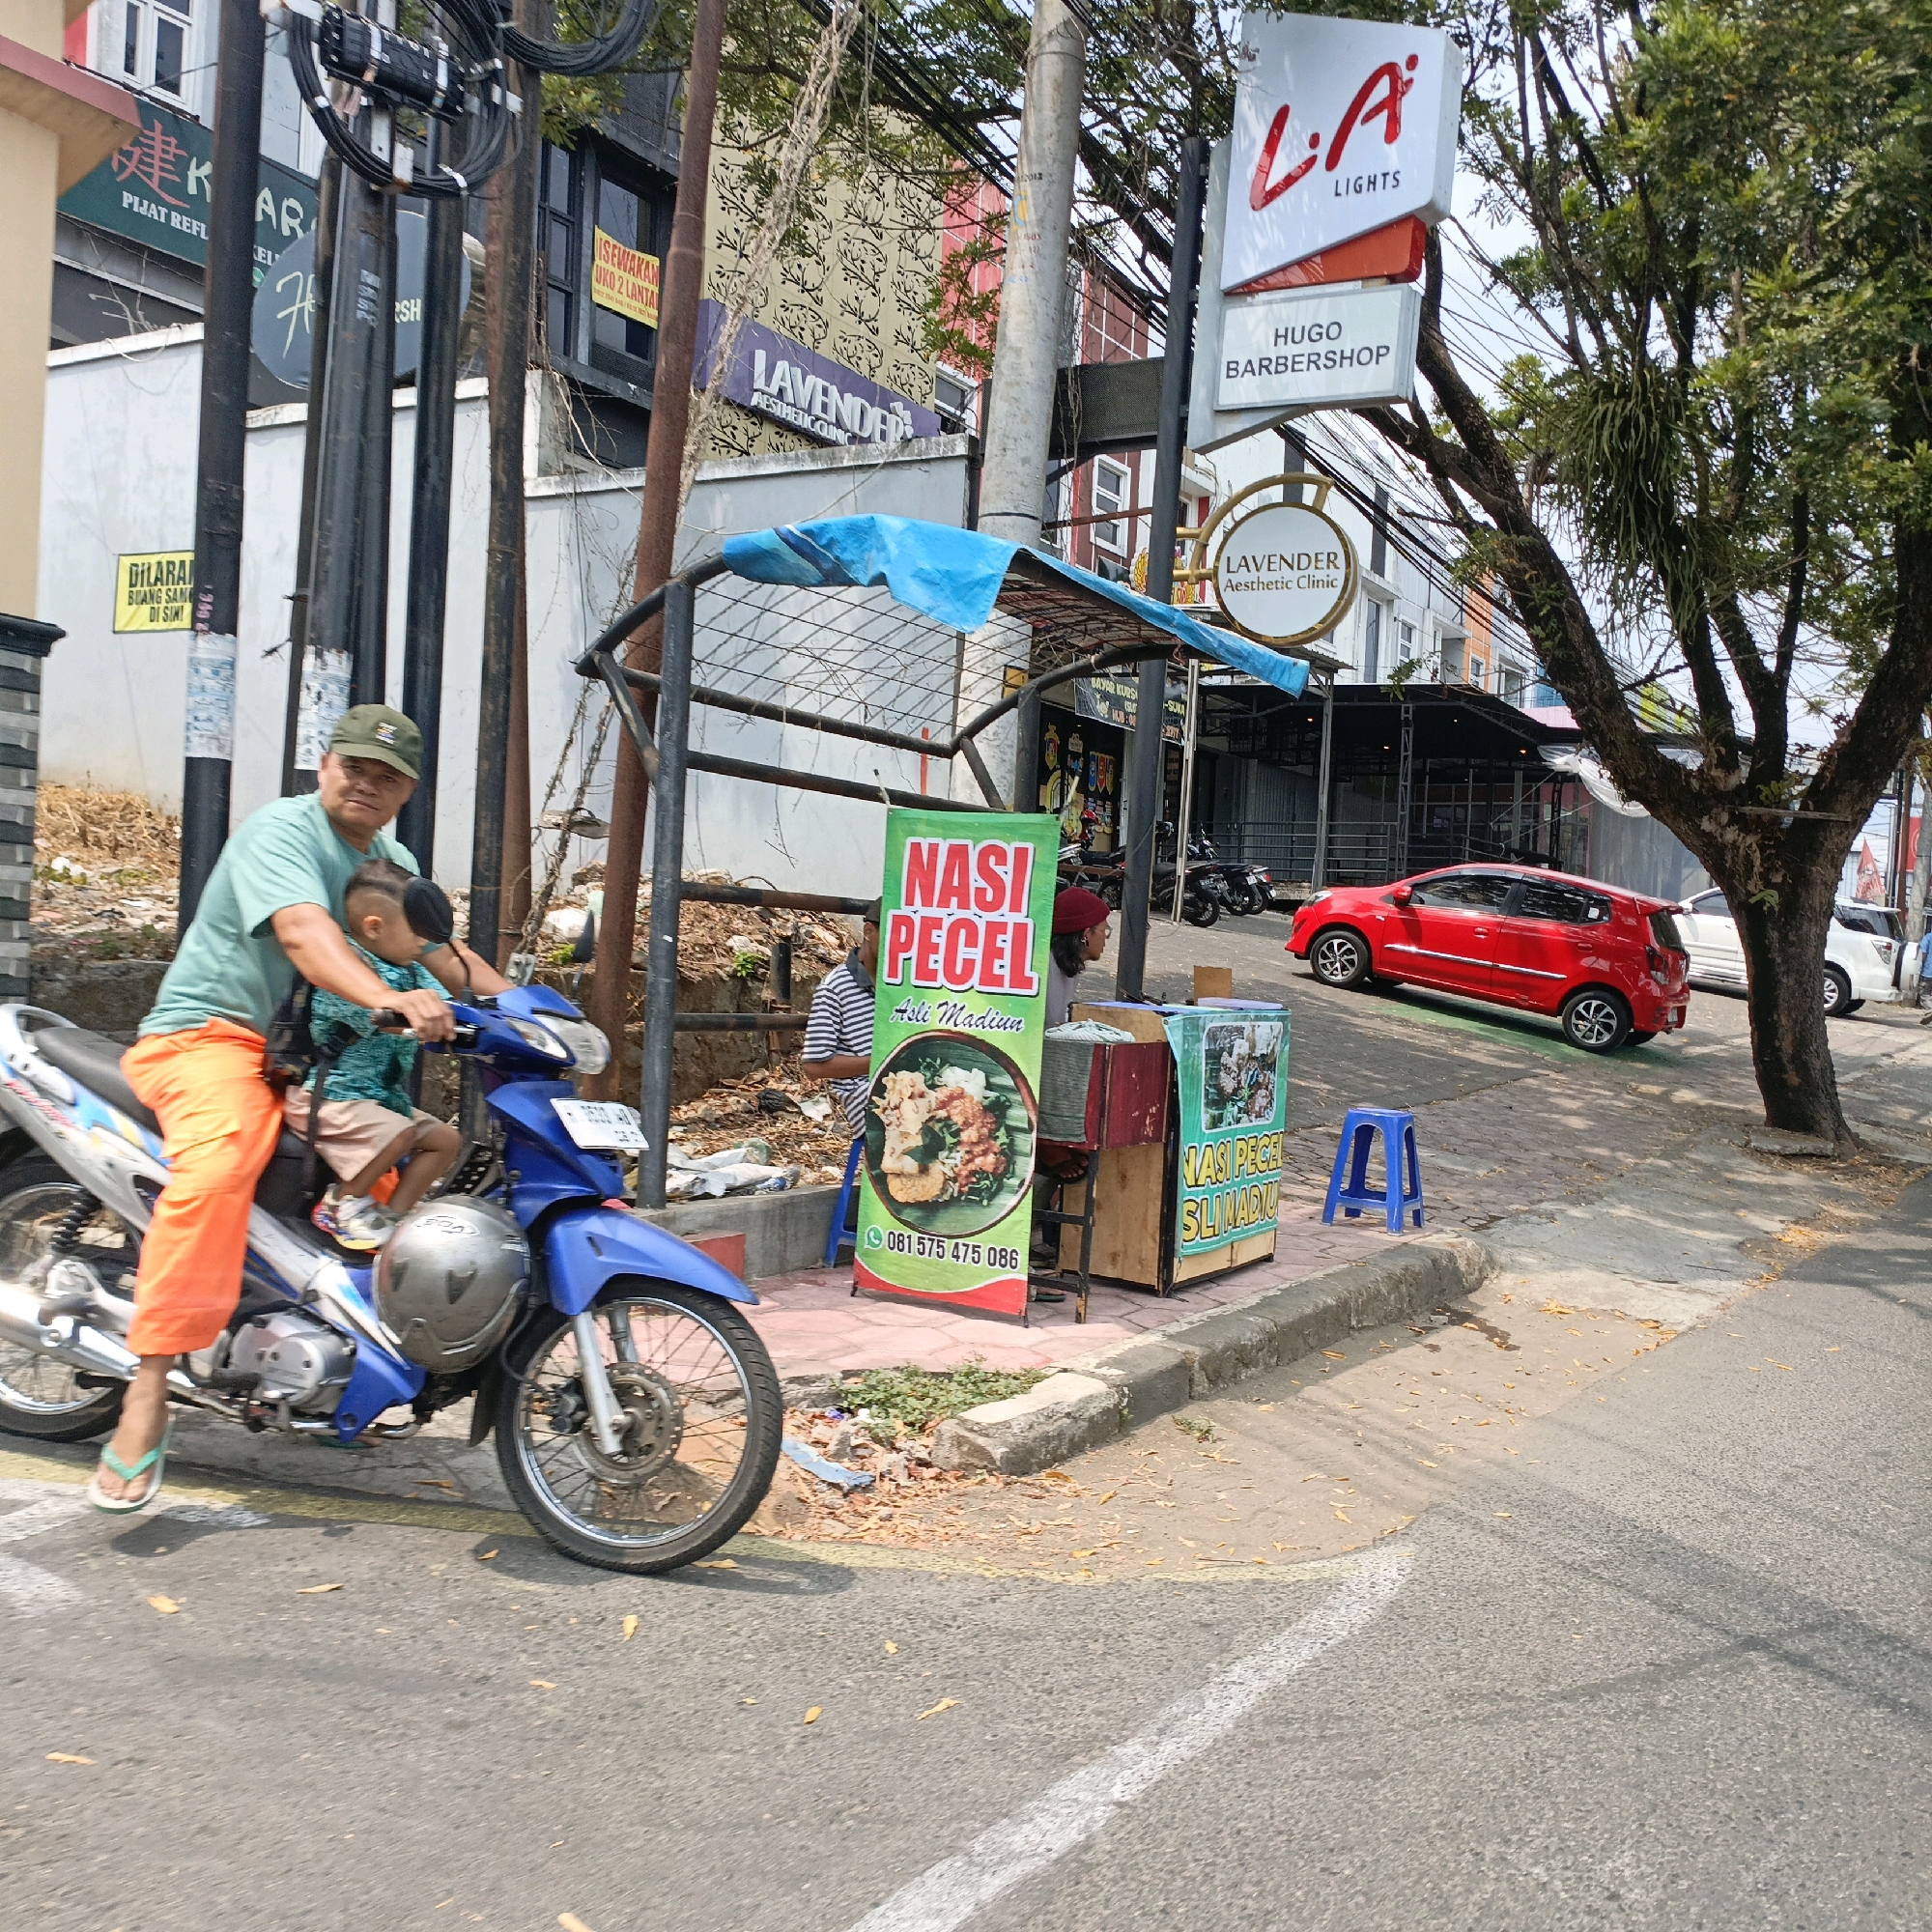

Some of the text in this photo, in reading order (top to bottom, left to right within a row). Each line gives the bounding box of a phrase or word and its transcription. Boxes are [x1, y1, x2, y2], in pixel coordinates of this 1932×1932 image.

[1334, 170, 1402, 197] LIGHTS
[122, 190, 168, 223] PIJAT
[171, 211, 210, 241] REFL
[617, 275, 624, 296] 2
[1273, 321, 1343, 347] HUGO
[1225, 345, 1391, 379] BARBERSHOP
[753, 349, 905, 442] LAVENDER
[750, 391, 816, 432] AESTHETIC
[1226, 552, 1341, 574] LAVENDER
[128, 587, 162, 606] BUANG
[1223, 574, 1339, 592] Aesthetic Clinic
[149, 606, 159, 623] DI
[1091, 676, 1116, 695] BAYAR
[903, 838, 1032, 916] NASI
[885, 912, 1037, 993] PECEL
[890, 998, 1025, 1032] Asli Madiun
[887, 1231, 1019, 1269] 081 575 475 086
